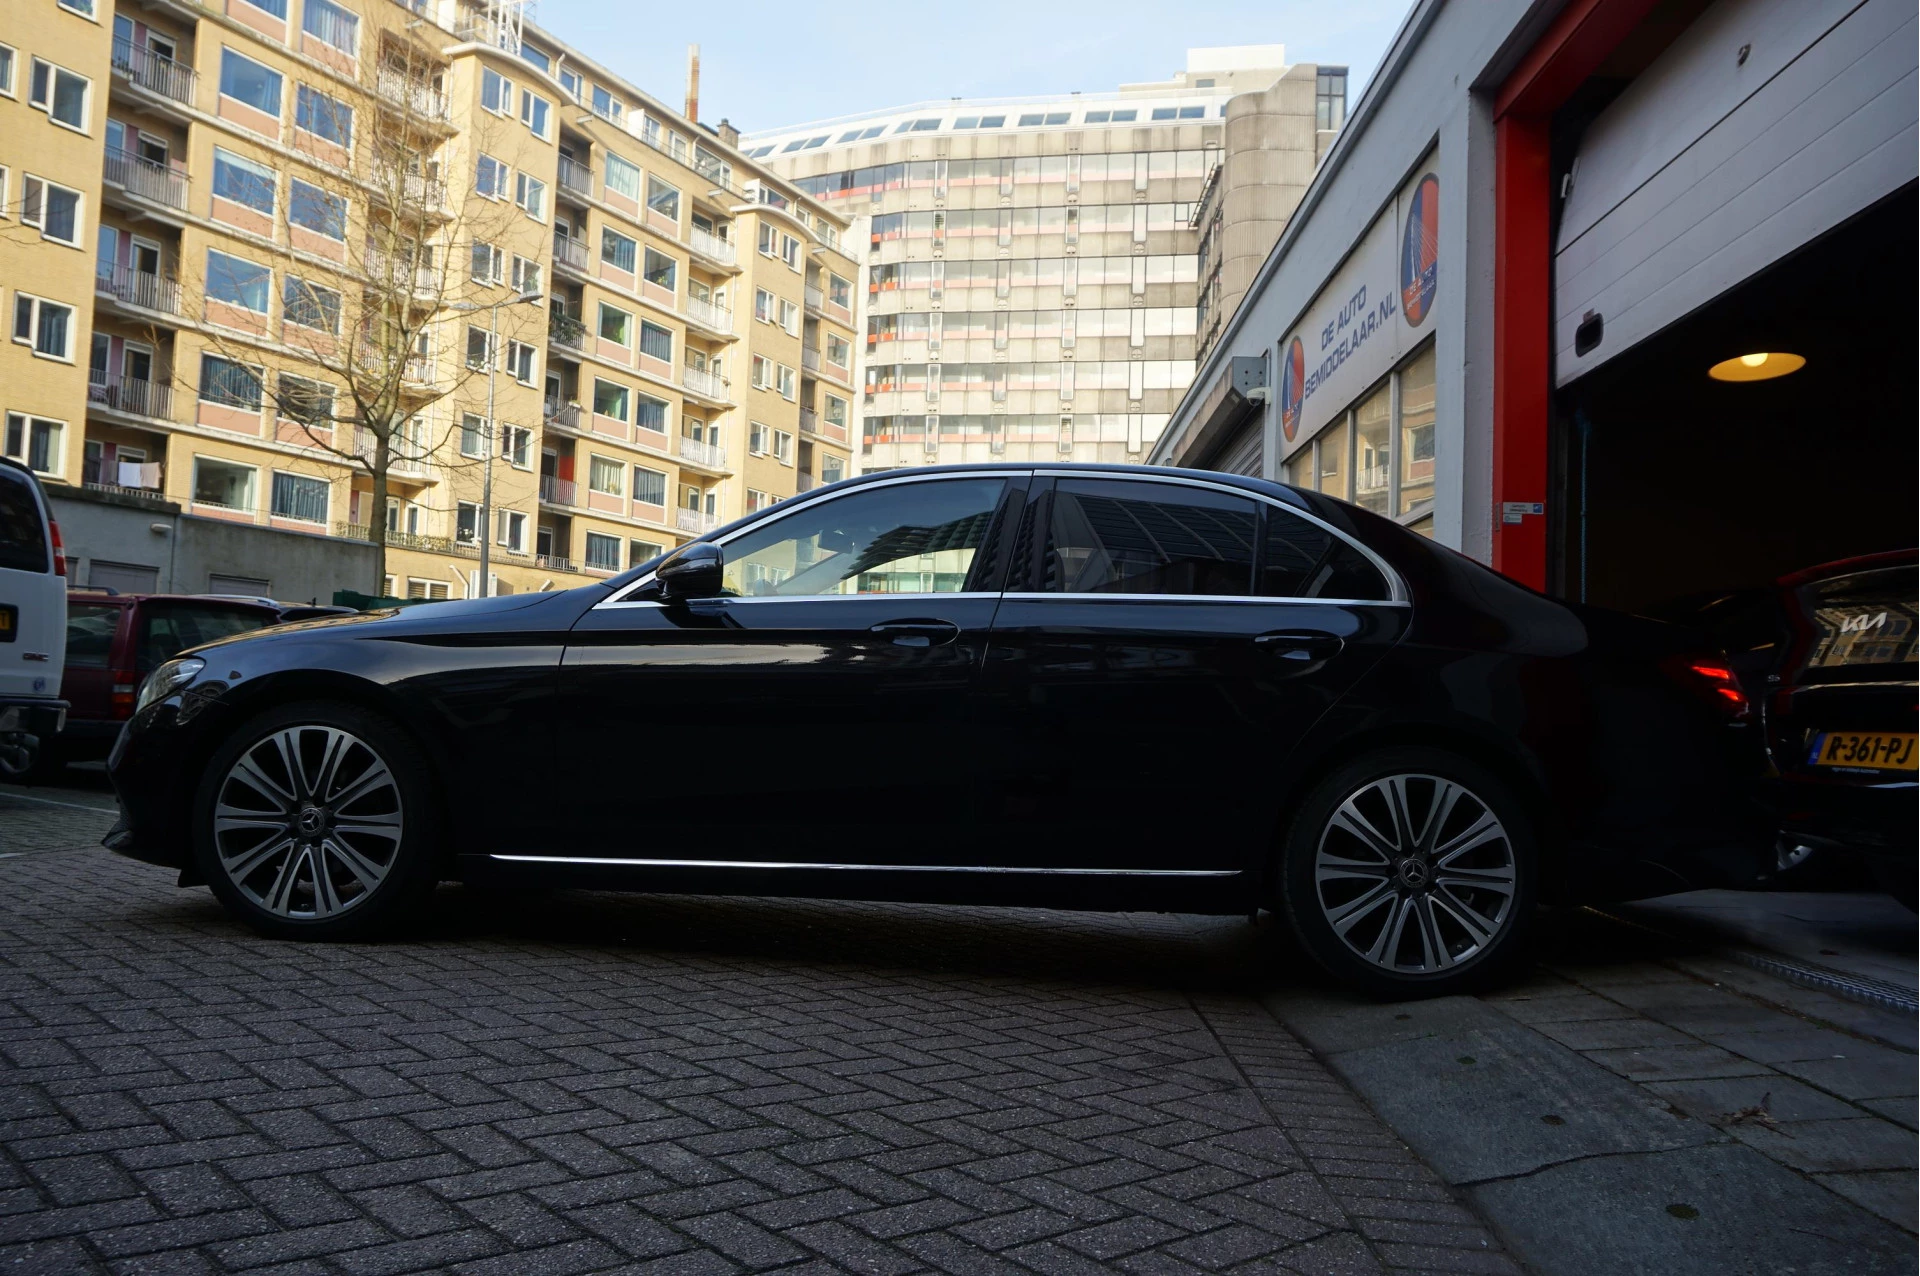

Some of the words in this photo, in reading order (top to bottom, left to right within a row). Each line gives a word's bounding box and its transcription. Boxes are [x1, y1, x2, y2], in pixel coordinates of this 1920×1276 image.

[1304, 291, 1397, 399] BEMIDDELAAR.NL
[1321, 319, 1335, 352] DE
[1336, 284, 1367, 335] AUTO
[1826, 735, 1915, 764] R-361-PJ
